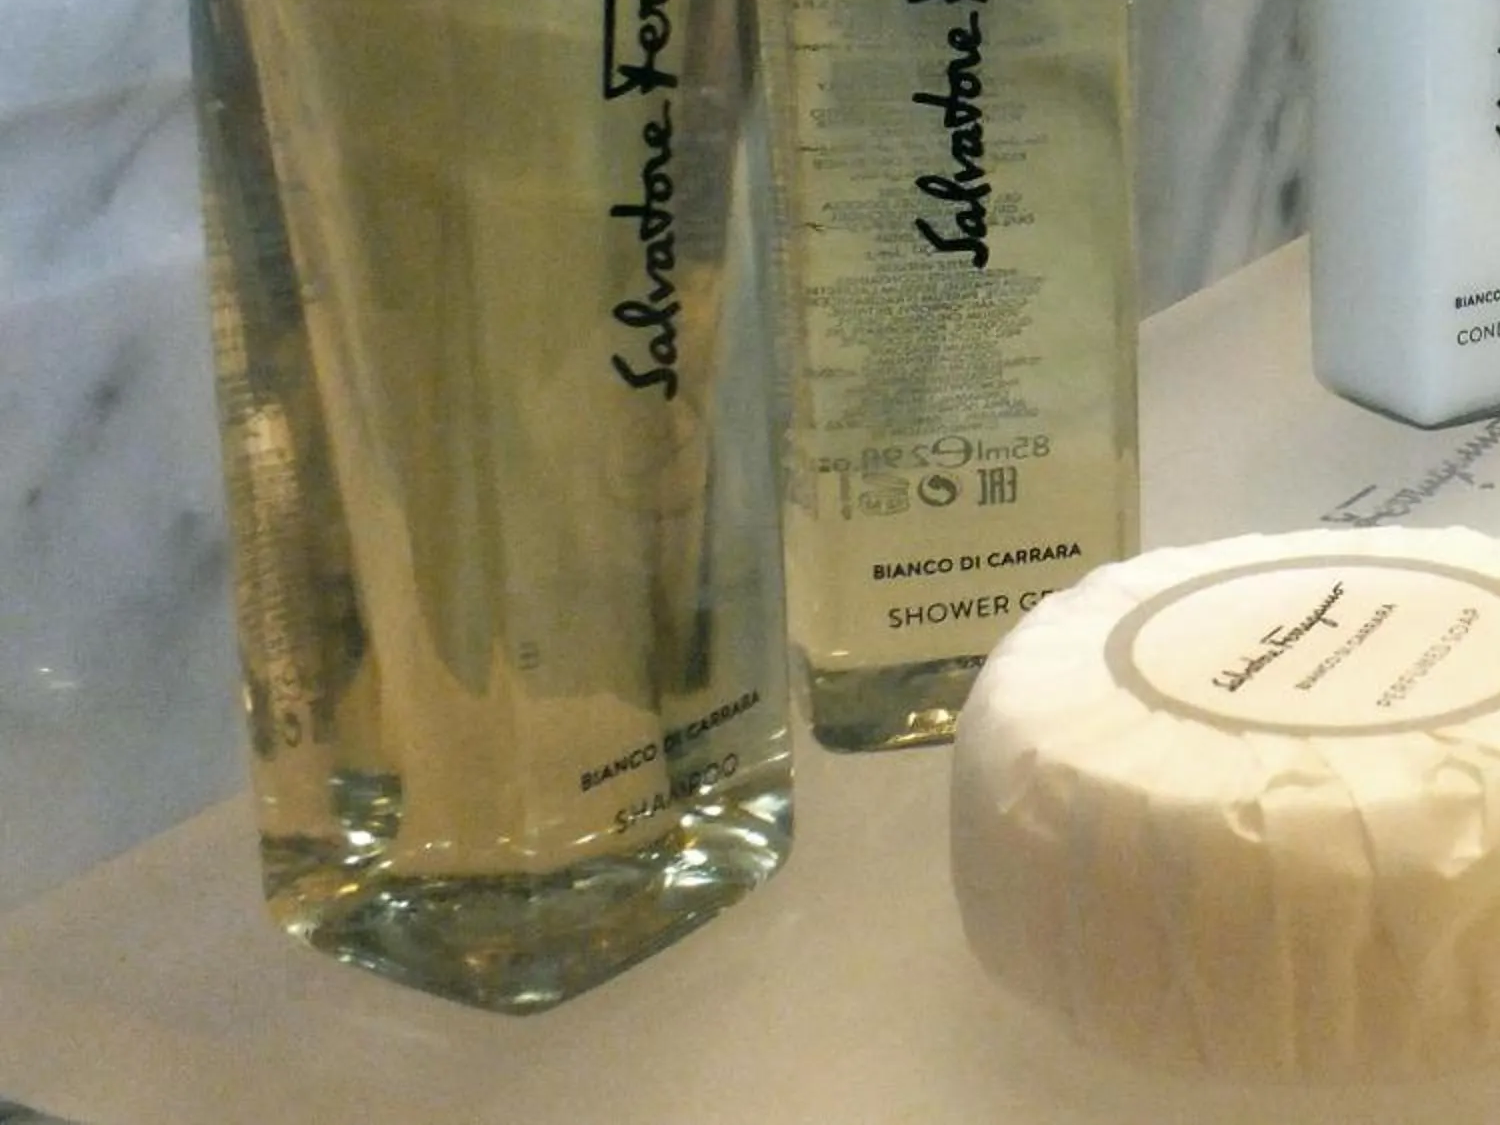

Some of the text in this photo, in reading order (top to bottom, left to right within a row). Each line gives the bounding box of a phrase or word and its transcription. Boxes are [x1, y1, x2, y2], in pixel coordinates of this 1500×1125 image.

[912, 11, 991, 269] Salvatore
[610, 99, 681, 402] Salvatore
[872, 542, 1082, 580] BIANCO DI CARRARA
[889, 594, 1009, 629] SHOWER
[580, 743, 657, 792] BIANCO
[687, 691, 761, 740] CARRARA
